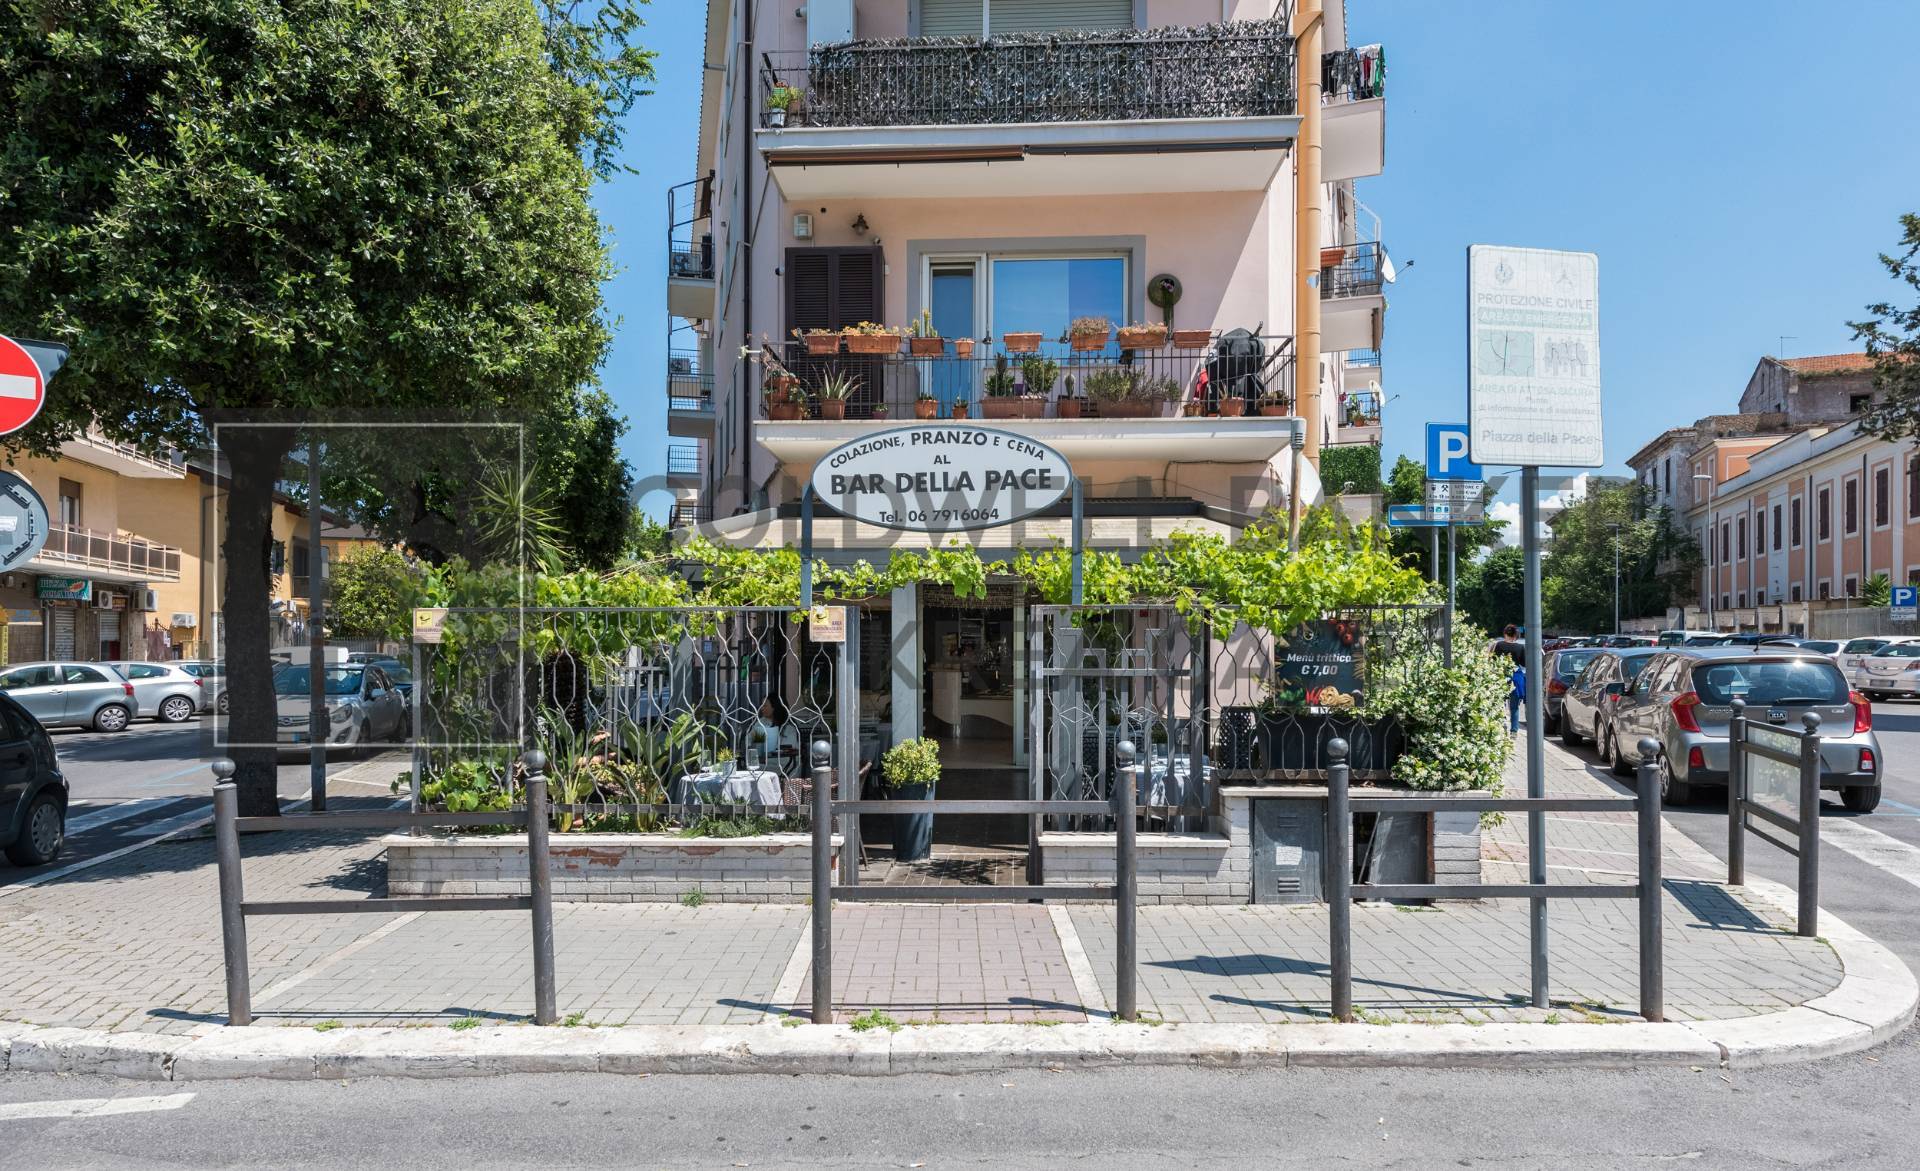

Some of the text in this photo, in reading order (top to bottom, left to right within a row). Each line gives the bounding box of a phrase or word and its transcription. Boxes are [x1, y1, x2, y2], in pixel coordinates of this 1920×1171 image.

[1477, 293, 1593, 310] PROTEZIONE CIVILE
[1481, 429, 1594, 445] Piazza della Pace
[830, 431, 1045, 468] COLAZIONE, PRANZO E CENA
[1439, 430, 1469, 473] P
[933, 454, 951, 465] AL
[831, 468, 1052, 495] BAR DELLA PACE
[879, 508, 999, 523] Tel. 06 7916064
[1895, 588, 1912, 605] P
[1312, 665, 1338, 676] 7,00
